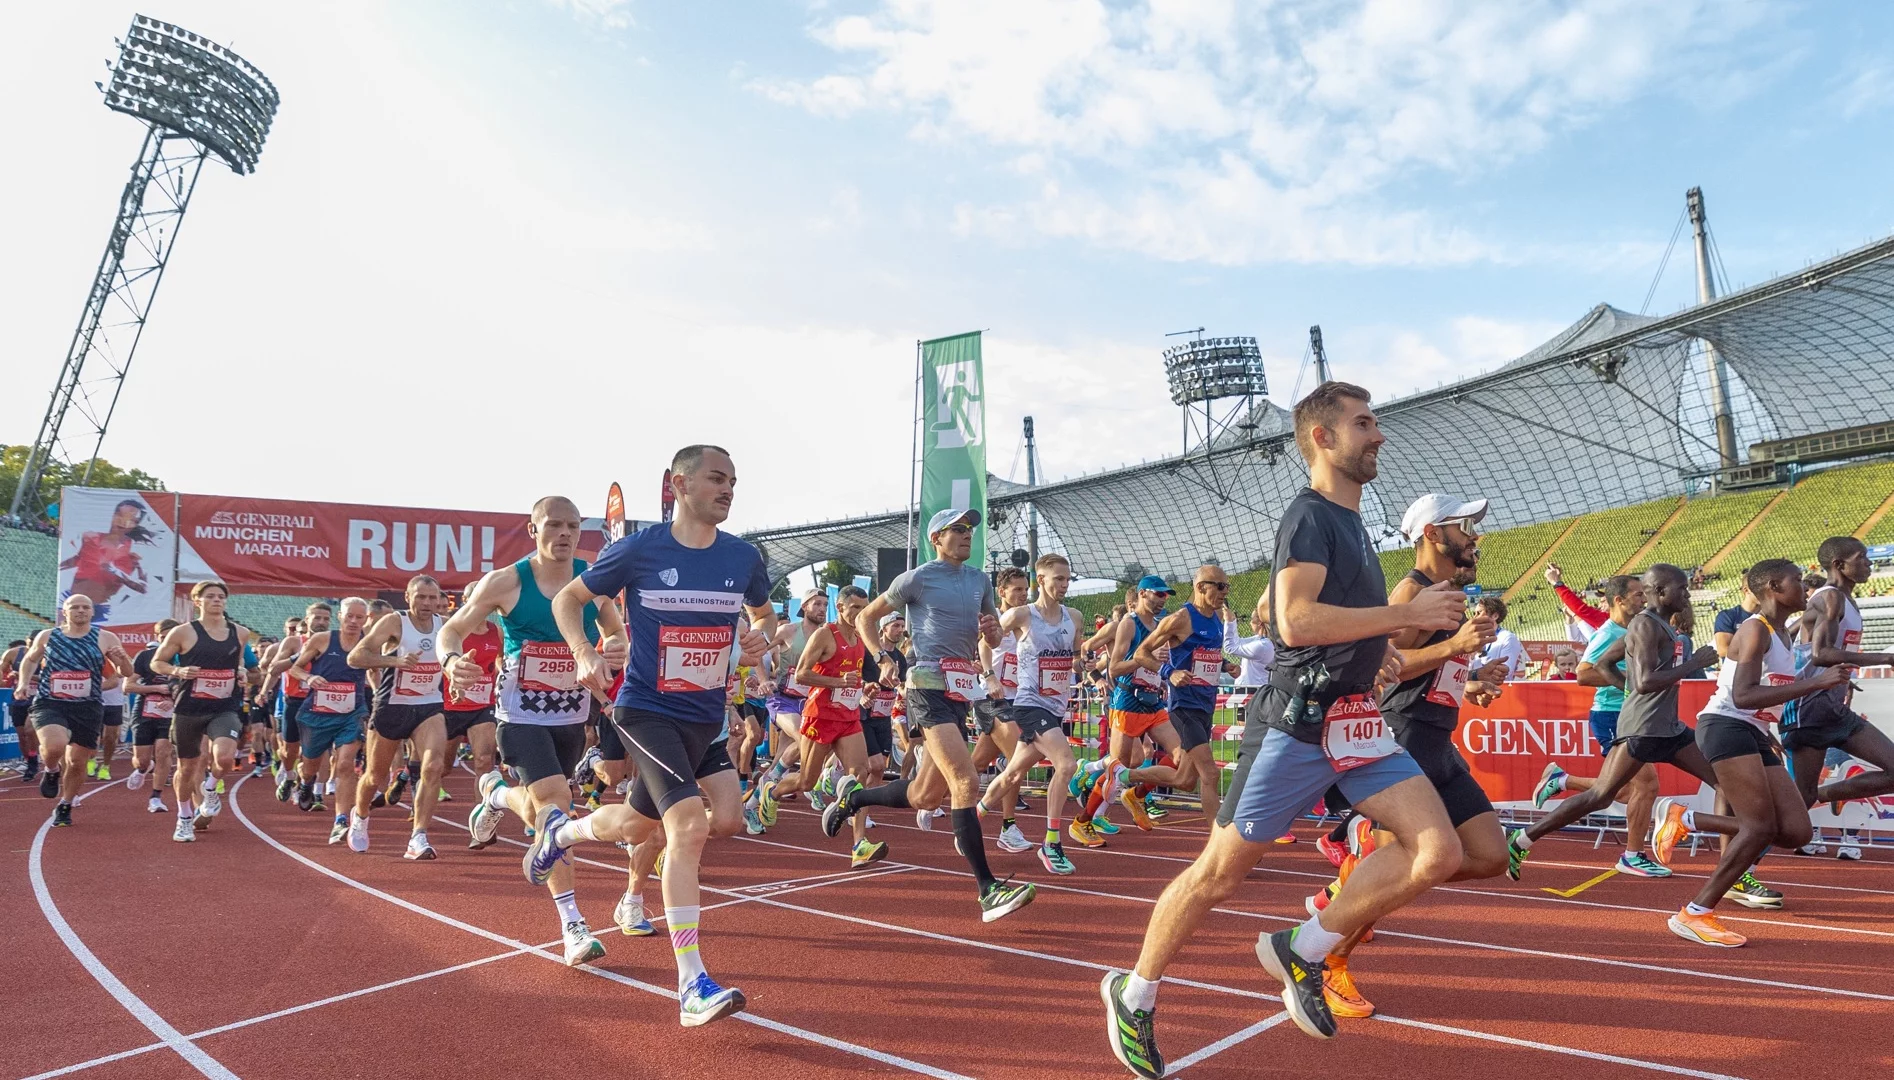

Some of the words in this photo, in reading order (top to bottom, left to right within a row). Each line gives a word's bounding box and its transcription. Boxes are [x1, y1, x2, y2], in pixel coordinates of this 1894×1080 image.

[236, 512, 315, 529] GENERALI
[195, 525, 293, 542] MÜNCHEN
[234, 543, 330, 559] MARATHON
[347, 519, 495, 572] RUN!
[679, 597, 736, 606] KLEINOSTHEIM
[680, 631, 731, 644] GENERALI
[681, 651, 720, 667] 2507
[538, 661, 575, 673] 2958
[410, 675, 434, 684] 2559
[1051, 672, 1068, 682] 2002
[205, 680, 228, 689] 2941
[325, 693, 348, 702] 1937
[840, 688, 857, 698] 2627
[1343, 719, 1383, 742] 1401
[1353, 740, 1377, 750] Marcus
